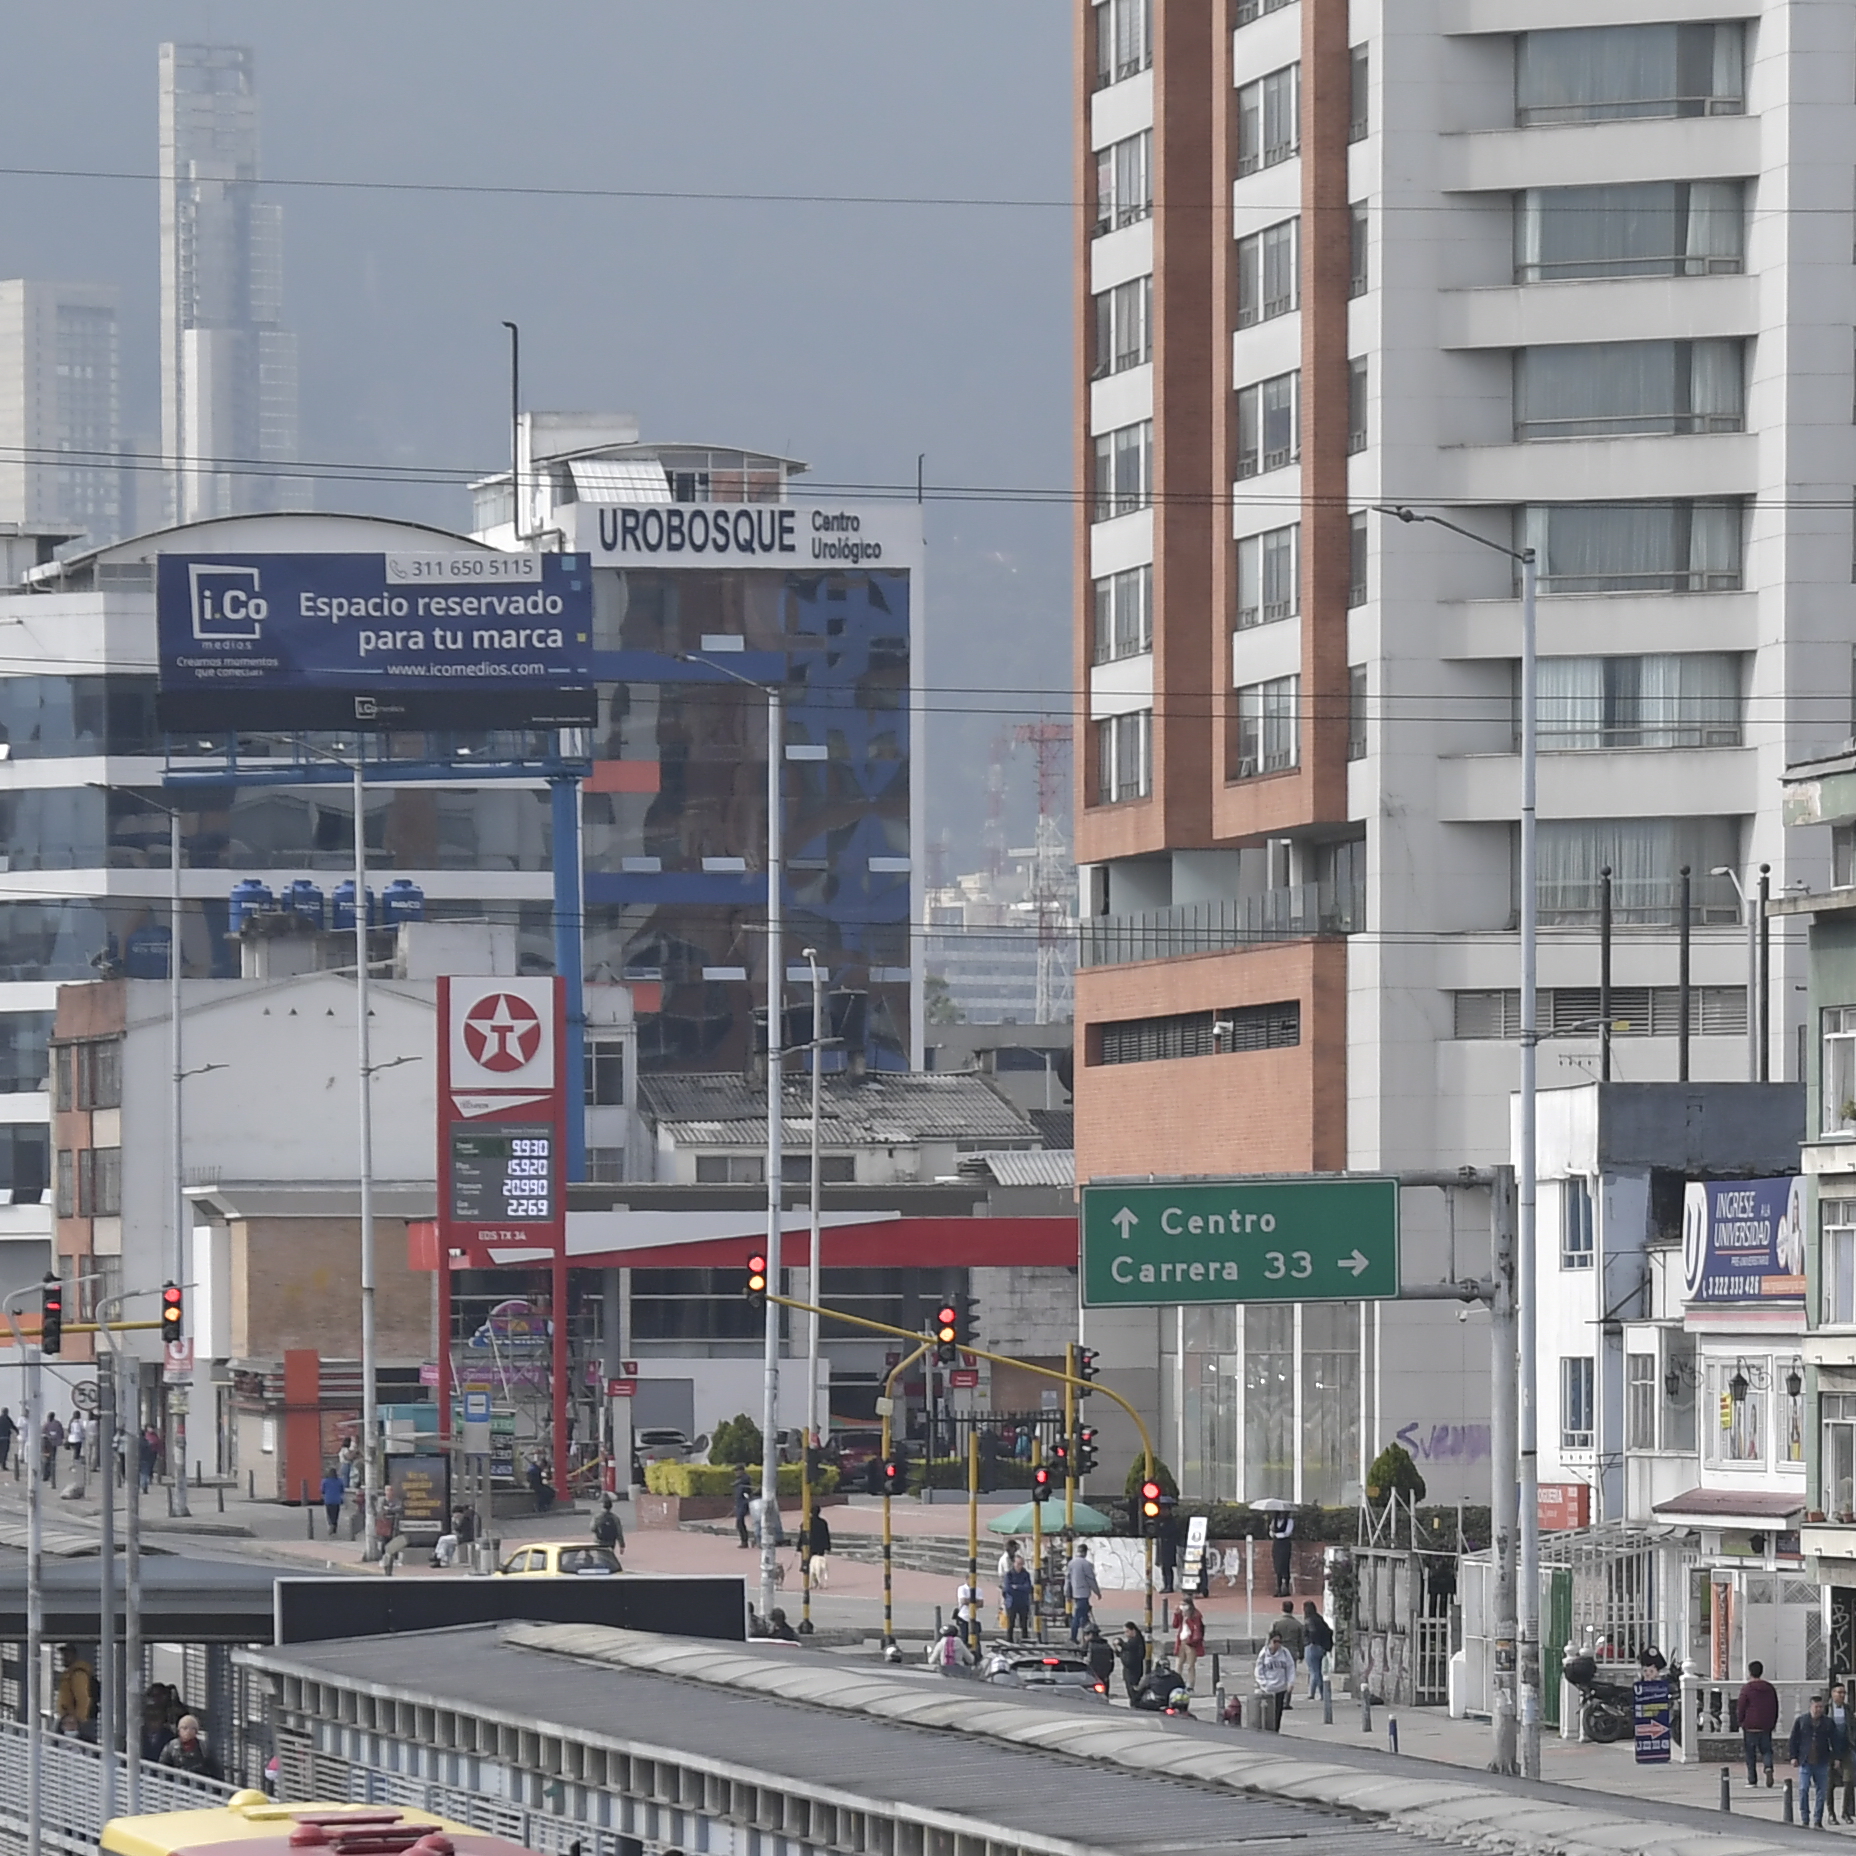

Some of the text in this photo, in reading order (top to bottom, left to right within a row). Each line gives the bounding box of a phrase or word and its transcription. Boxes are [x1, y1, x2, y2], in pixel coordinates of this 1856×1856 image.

[598, 507, 796, 555] UROBOSQUE
[811, 510, 860, 533] Centro
[811, 537, 882, 564] Urológico
[412, 558, 533, 577] 311 650 5115
[299, 590, 563, 624] Espacio reservado
[202, 640, 253, 650] medios
[359, 628, 563, 657] para tu marca
[177, 656, 279, 668] Creamos momentos
[195, 668, 215, 679] que
[387, 662, 544, 677] www.icomedios.com
[1715, 1191, 1756, 1219] INGRESE
[1160, 1206, 1277, 1235] Centro
[1714, 1220, 1771, 1247] UNIVERSIDAD
[1111, 1251, 1312, 1284] Carrera 33
